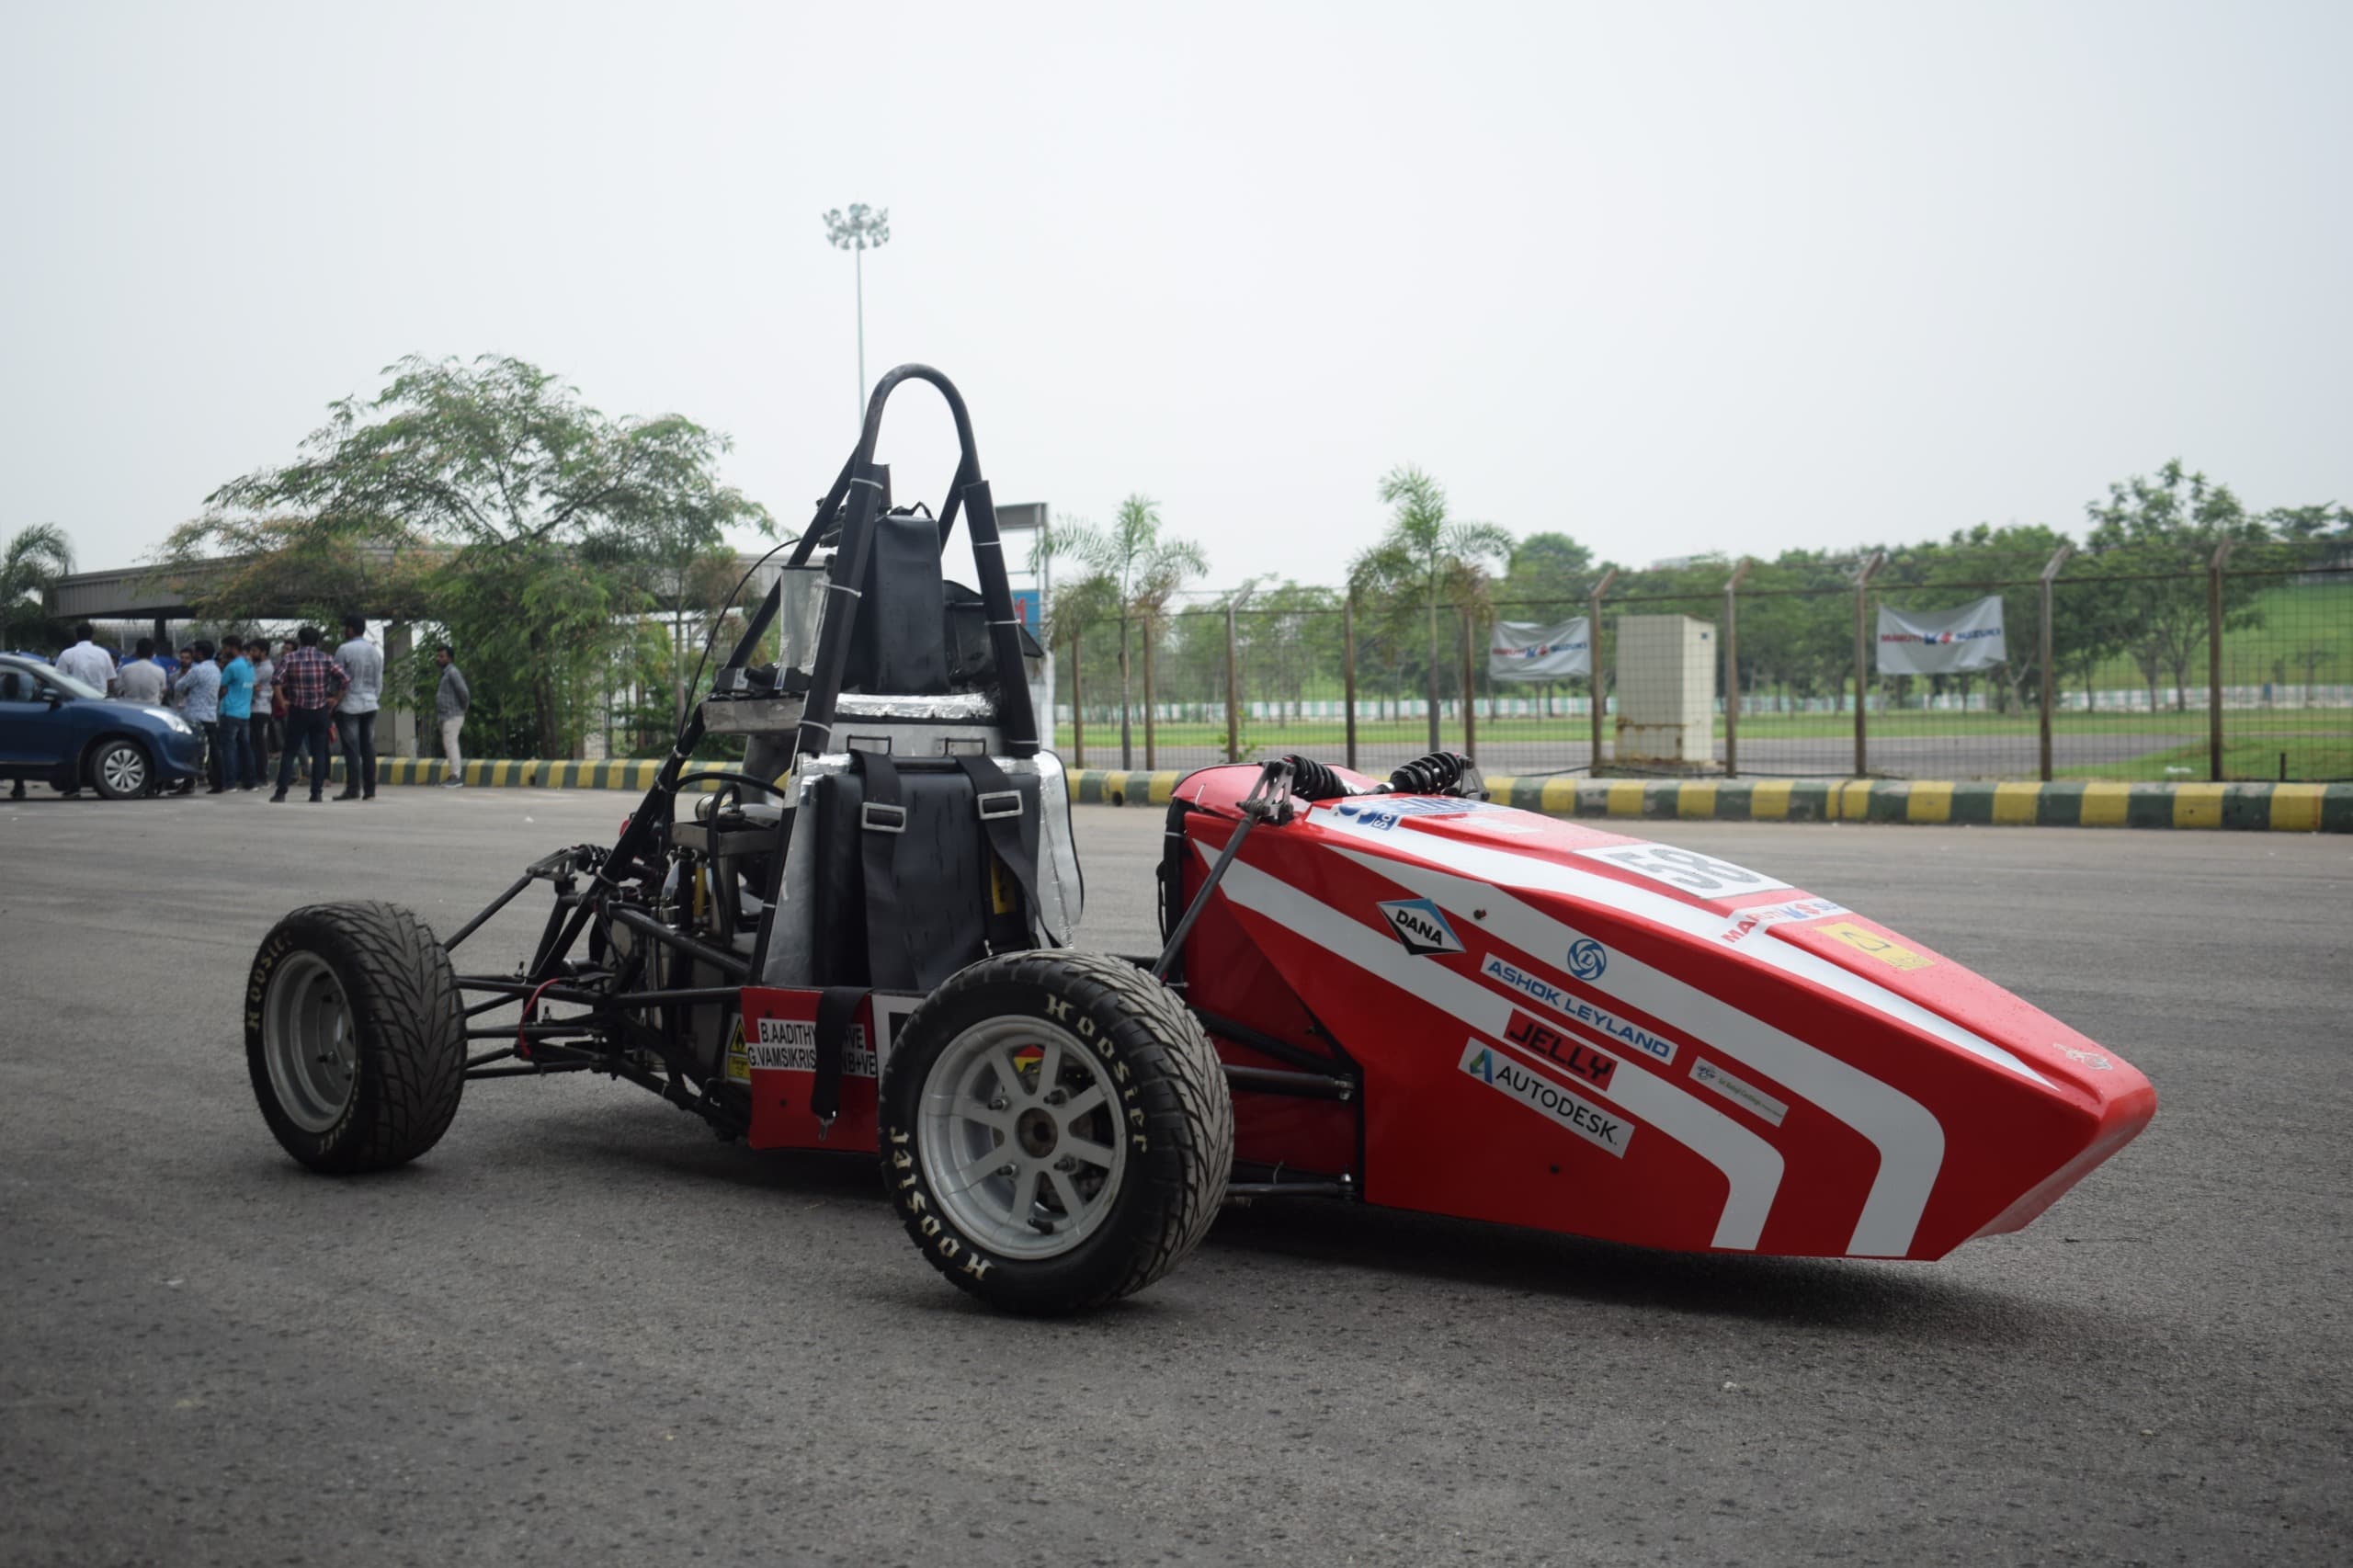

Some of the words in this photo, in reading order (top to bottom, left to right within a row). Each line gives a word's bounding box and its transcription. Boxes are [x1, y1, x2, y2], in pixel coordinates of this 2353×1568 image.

[1607, 848, 1761, 889] 58
[1395, 909, 1443, 946] DANA
[1487, 960, 1560, 1006] ASHOK
[1564, 998, 1671, 1058] LEYLAND
[1508, 1023, 1612, 1081] JELLY
